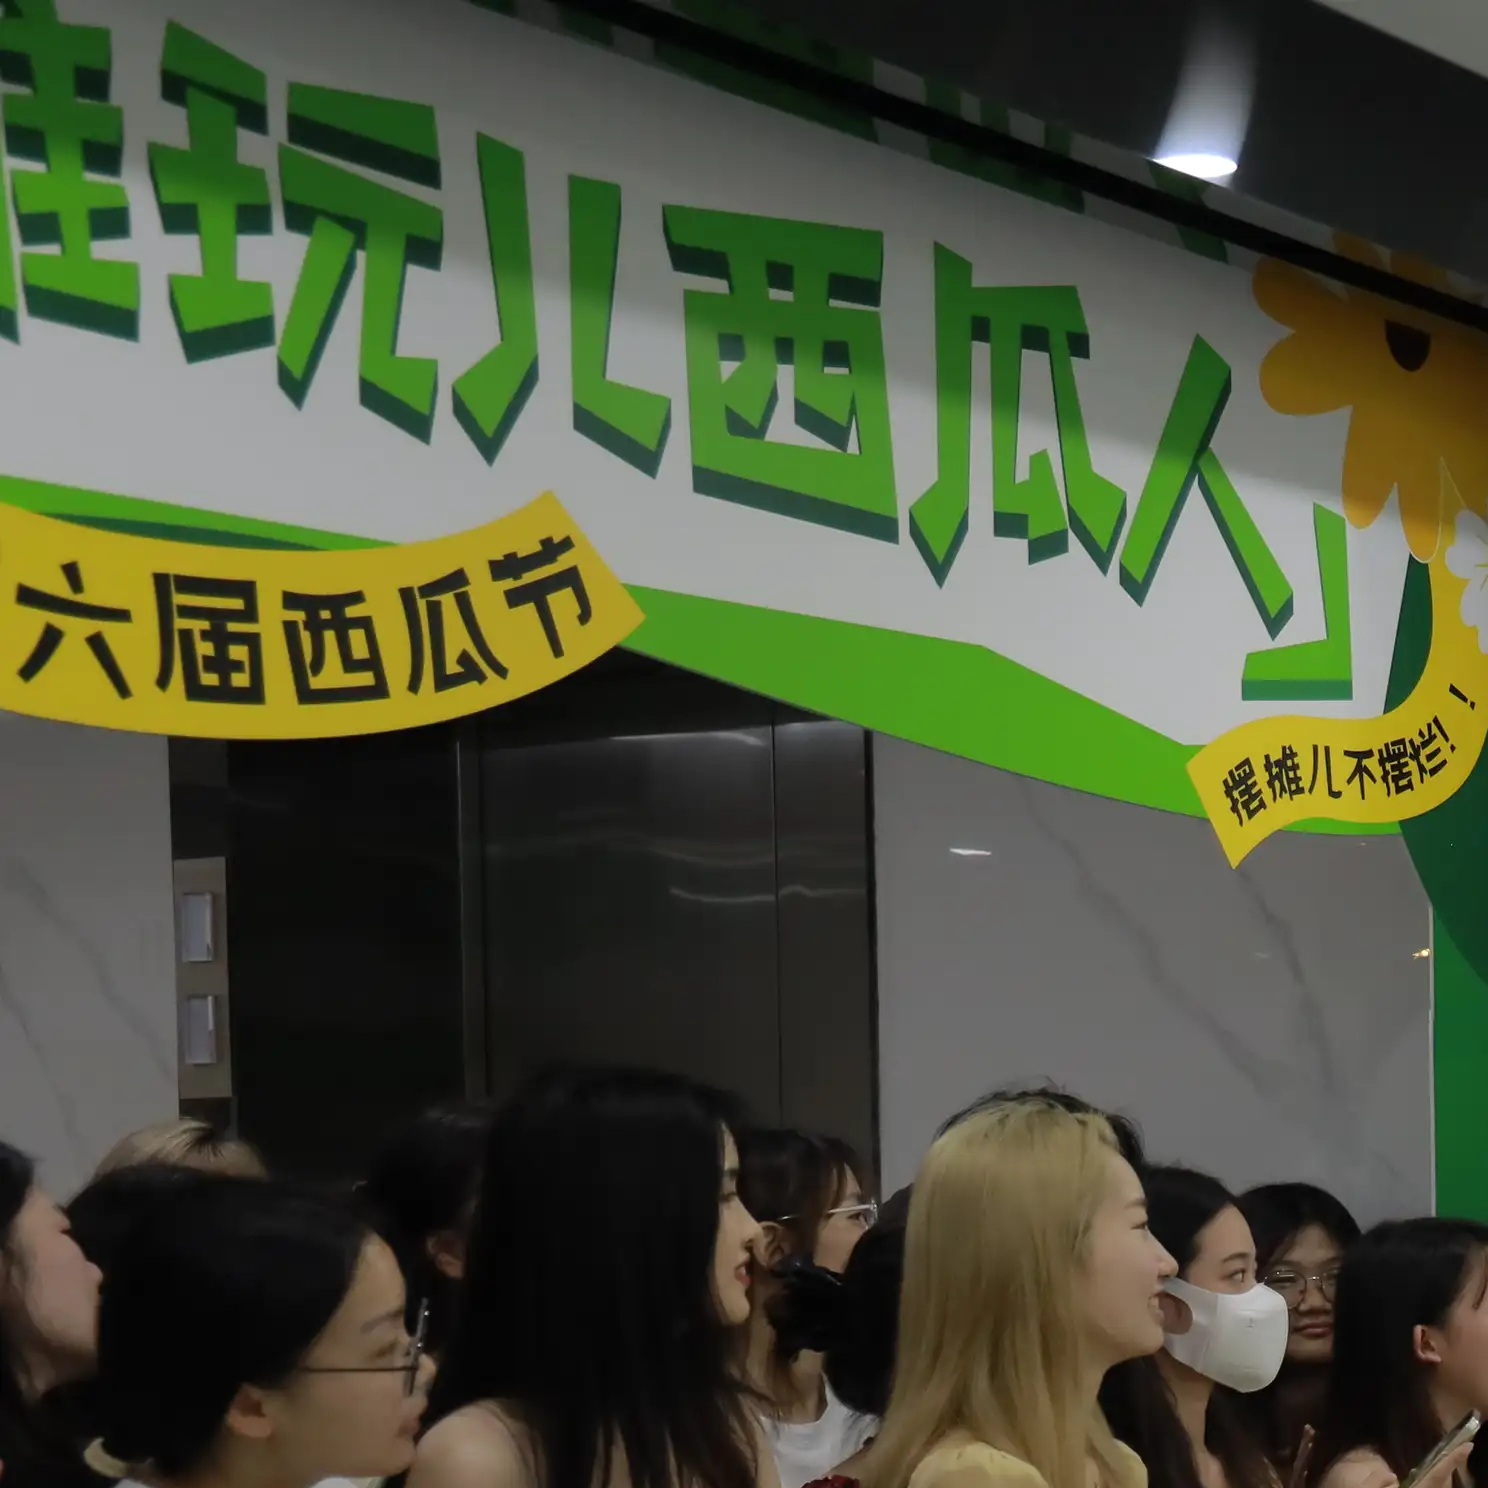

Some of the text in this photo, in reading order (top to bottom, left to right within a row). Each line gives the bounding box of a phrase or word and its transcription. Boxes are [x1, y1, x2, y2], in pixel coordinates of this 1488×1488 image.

[15, 534, 594, 706] 六届西瓜节
